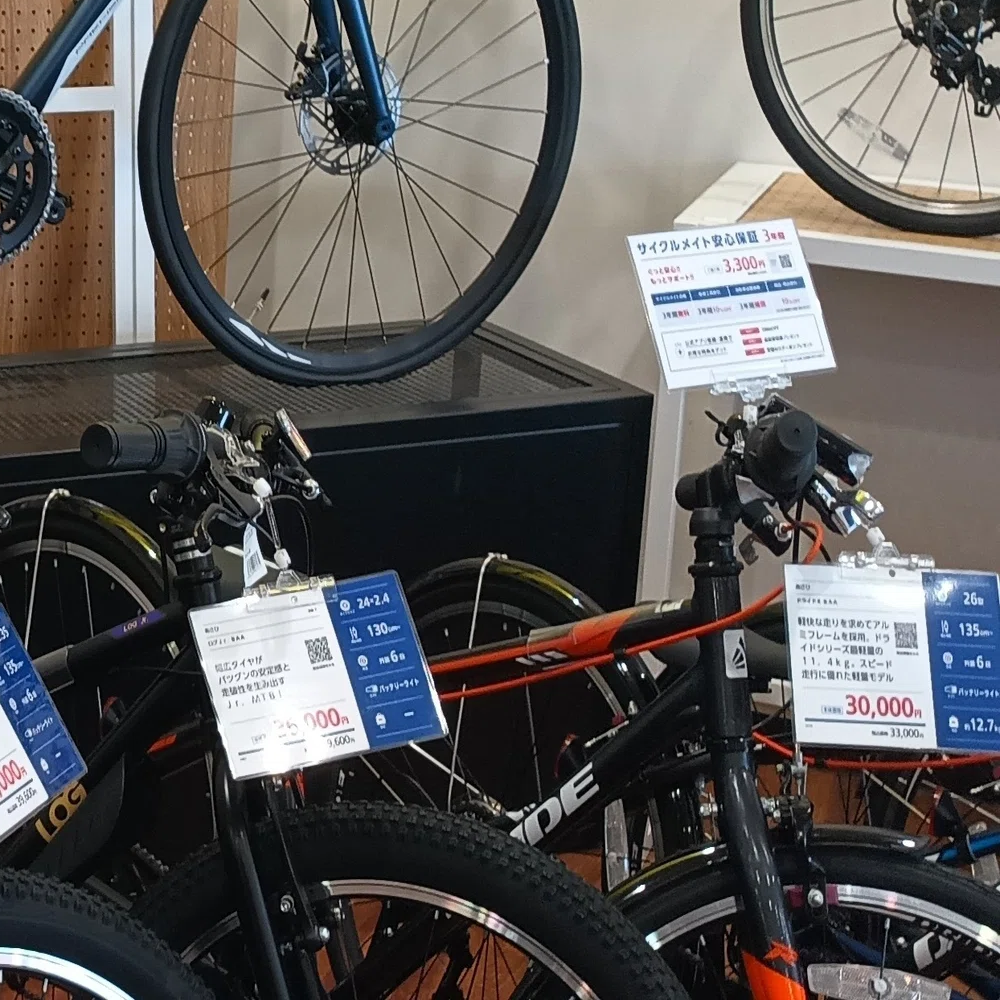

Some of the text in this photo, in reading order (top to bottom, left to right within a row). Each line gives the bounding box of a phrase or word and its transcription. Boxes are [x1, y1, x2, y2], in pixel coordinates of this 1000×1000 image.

[637, 230, 759, 255] サイクルメイト安心保証
[798, 617, 889, 630] 軽快な走りを求めてアル
[800, 642, 883, 655] イドシリーズ最軽量の
[846, 695, 922, 721] 30,000円
[326, 733, 355, 747] 9,600円
[34, 780, 87, 843] LOG
